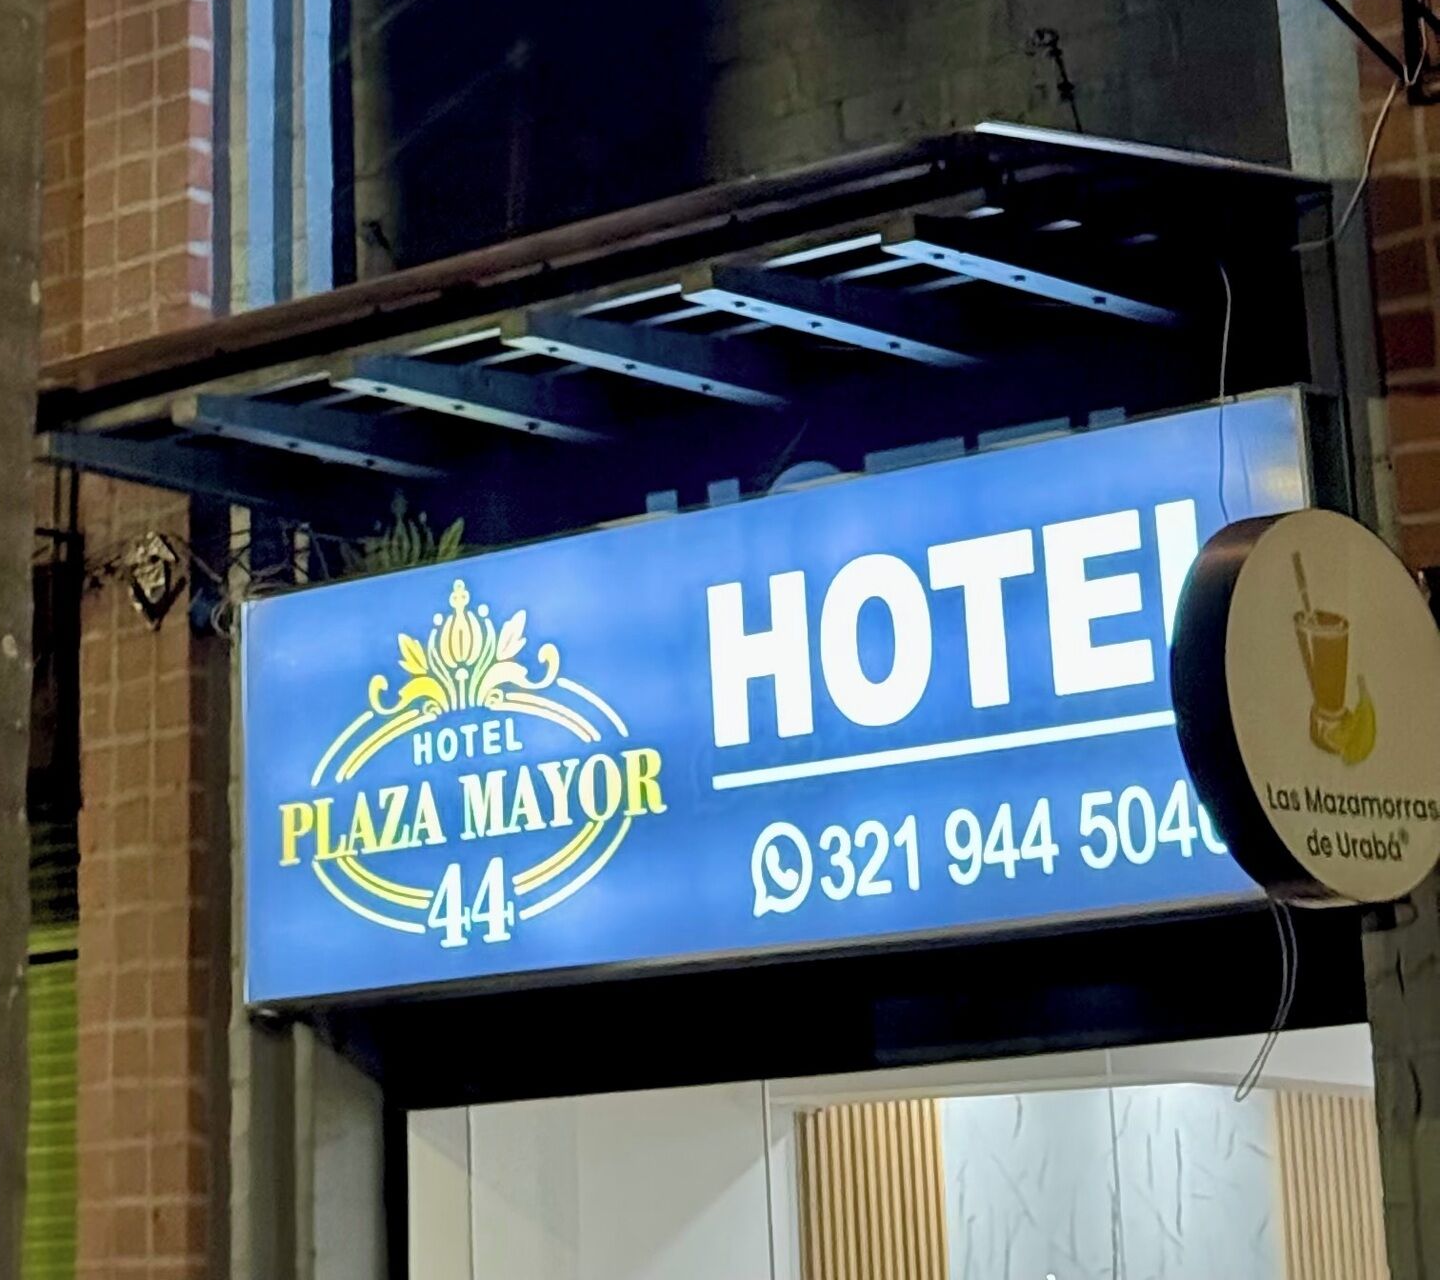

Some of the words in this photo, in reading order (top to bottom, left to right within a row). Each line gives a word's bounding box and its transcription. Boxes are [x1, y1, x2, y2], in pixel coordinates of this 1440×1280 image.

[413, 717, 523, 765] HOTEL
[278, 785, 446, 867] PLAZA
[459, 747, 667, 841] MAYOR
[1266, 782, 1301, 811] Las
[1304, 785, 1440, 821] Mazamorras
[820, 816, 920, 901] 321
[944, 799, 1059, 886] 944
[1307, 827, 1333, 858] de
[428, 856, 515, 948] 44
